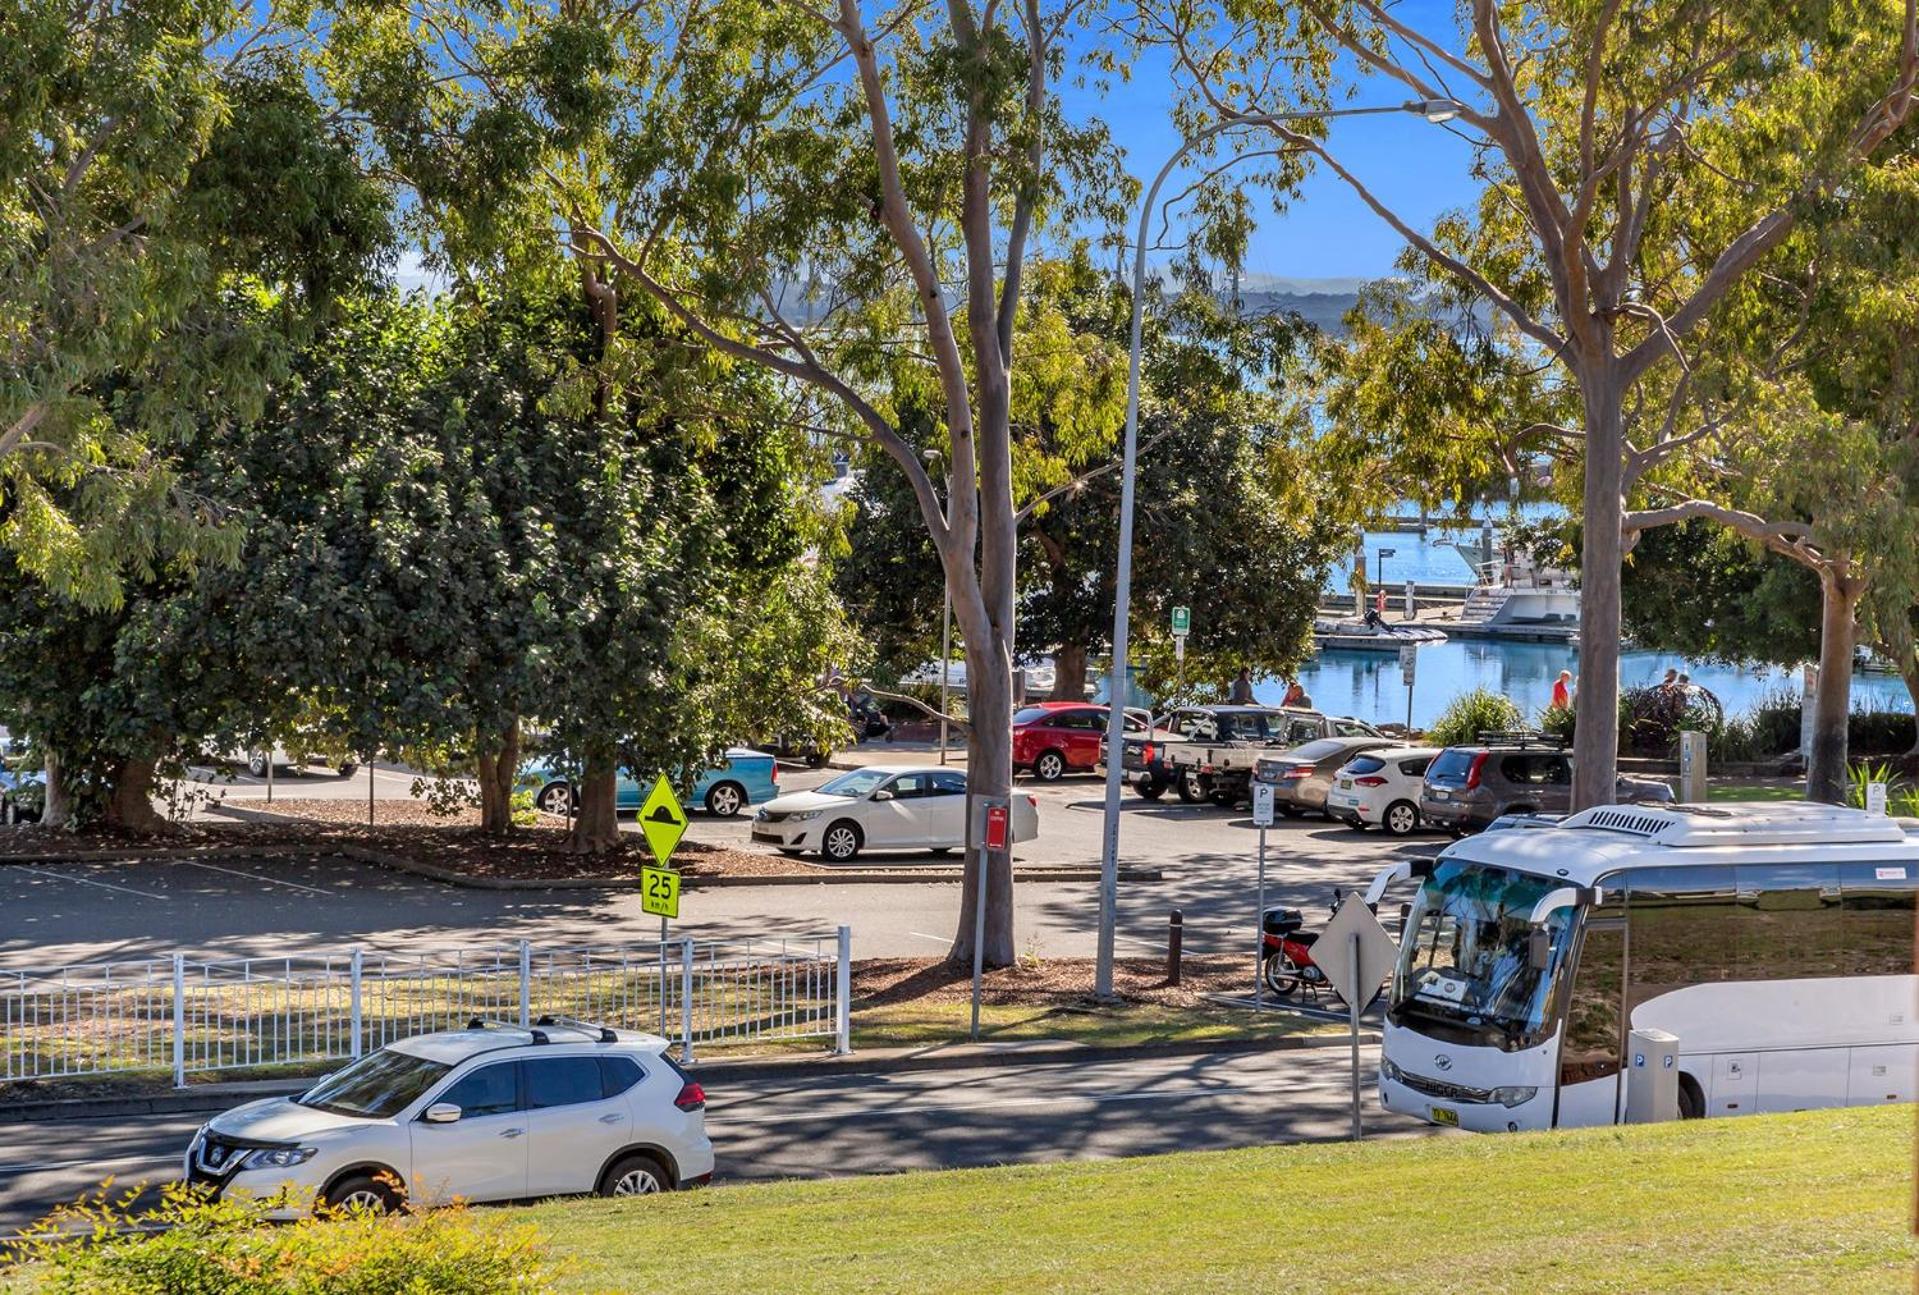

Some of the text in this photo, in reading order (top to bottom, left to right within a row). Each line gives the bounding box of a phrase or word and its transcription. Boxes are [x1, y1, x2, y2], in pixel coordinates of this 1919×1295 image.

[1260, 788, 1268, 798] P
[650, 874, 671, 899] 25
[1636, 1055, 1644, 1065] P
[1665, 1056, 1672, 1067] P
